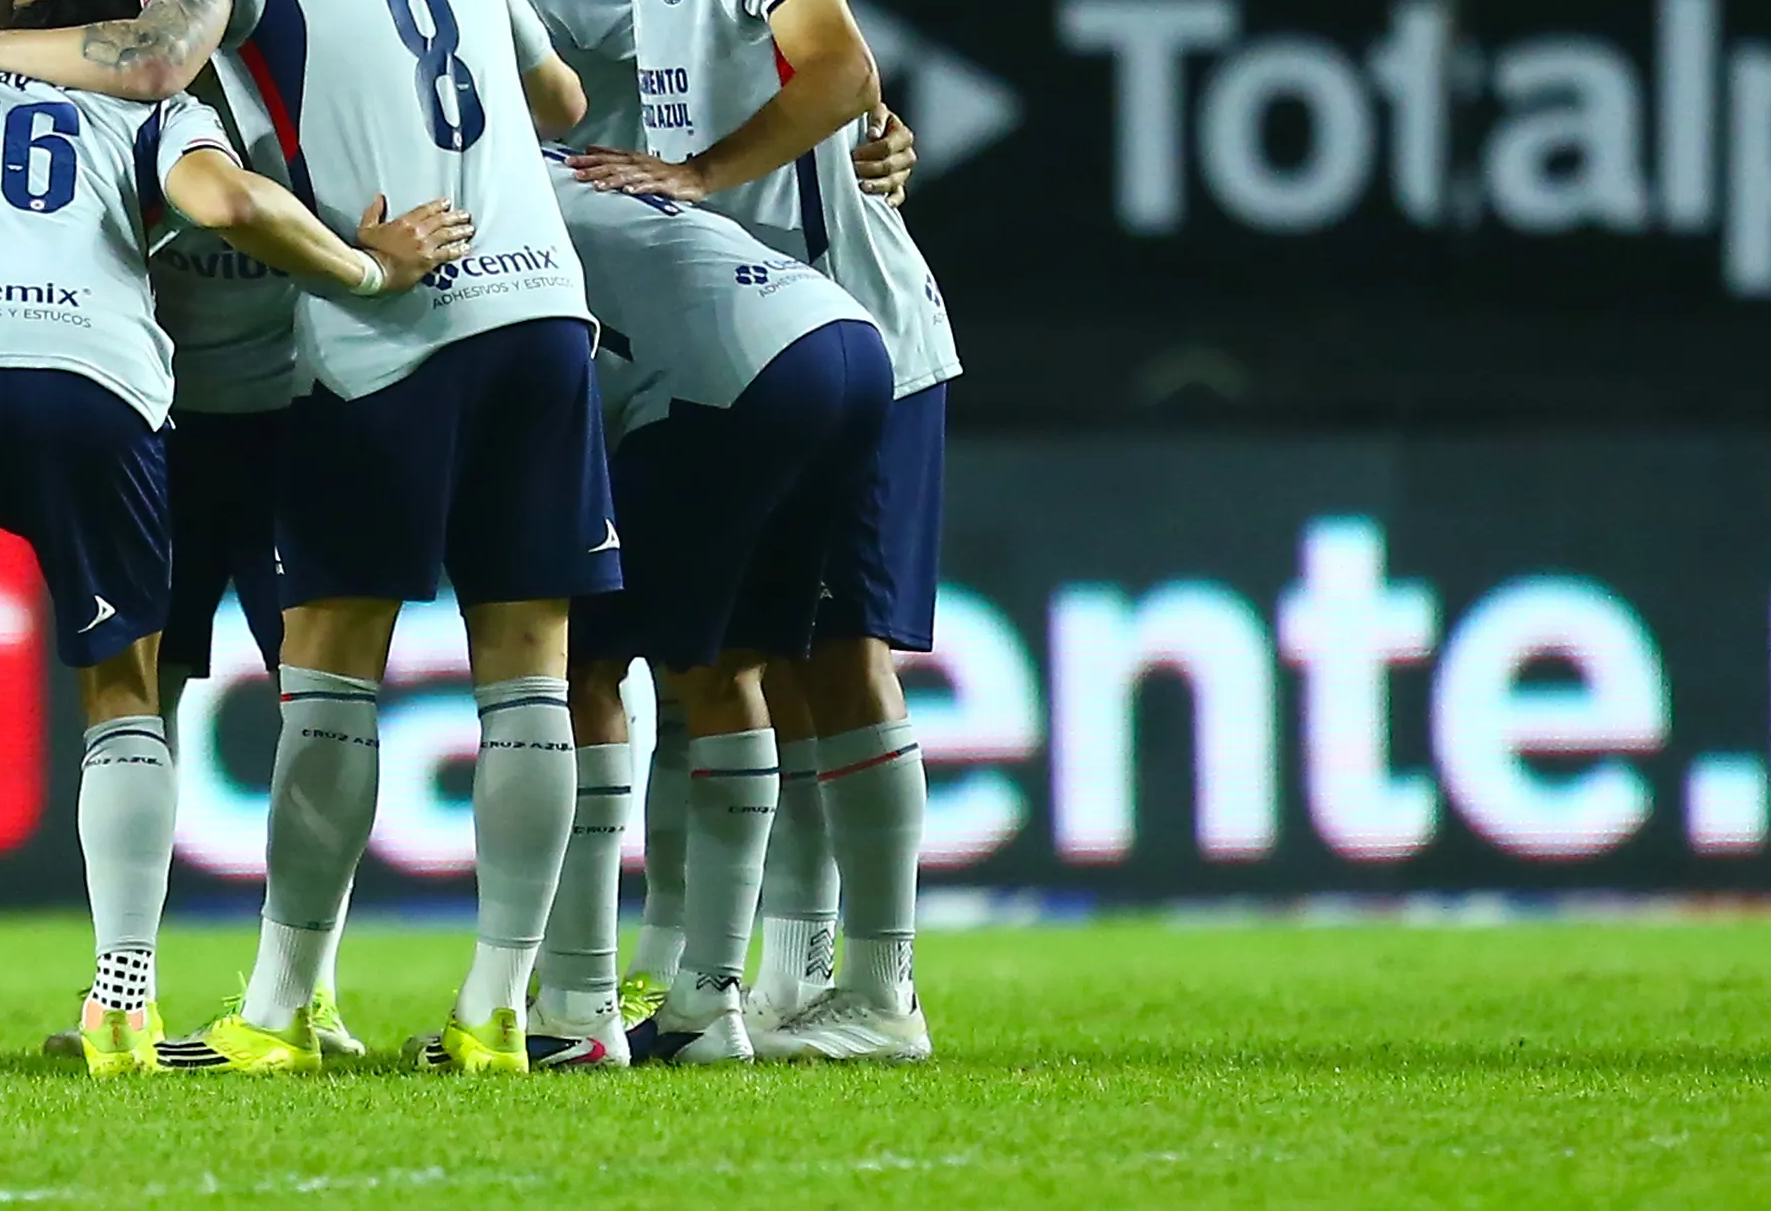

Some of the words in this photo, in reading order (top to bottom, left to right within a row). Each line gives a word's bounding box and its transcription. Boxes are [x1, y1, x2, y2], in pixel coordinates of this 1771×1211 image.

[461, 245, 559, 277] cemix
[432, 282, 509, 310] ADHESIVOS
[511, 281, 521, 290] Y
[8, 309, 17, 317] Y
[23, 309, 92, 328] ESTUCOS
[302, 729, 348, 741] CRUZ
